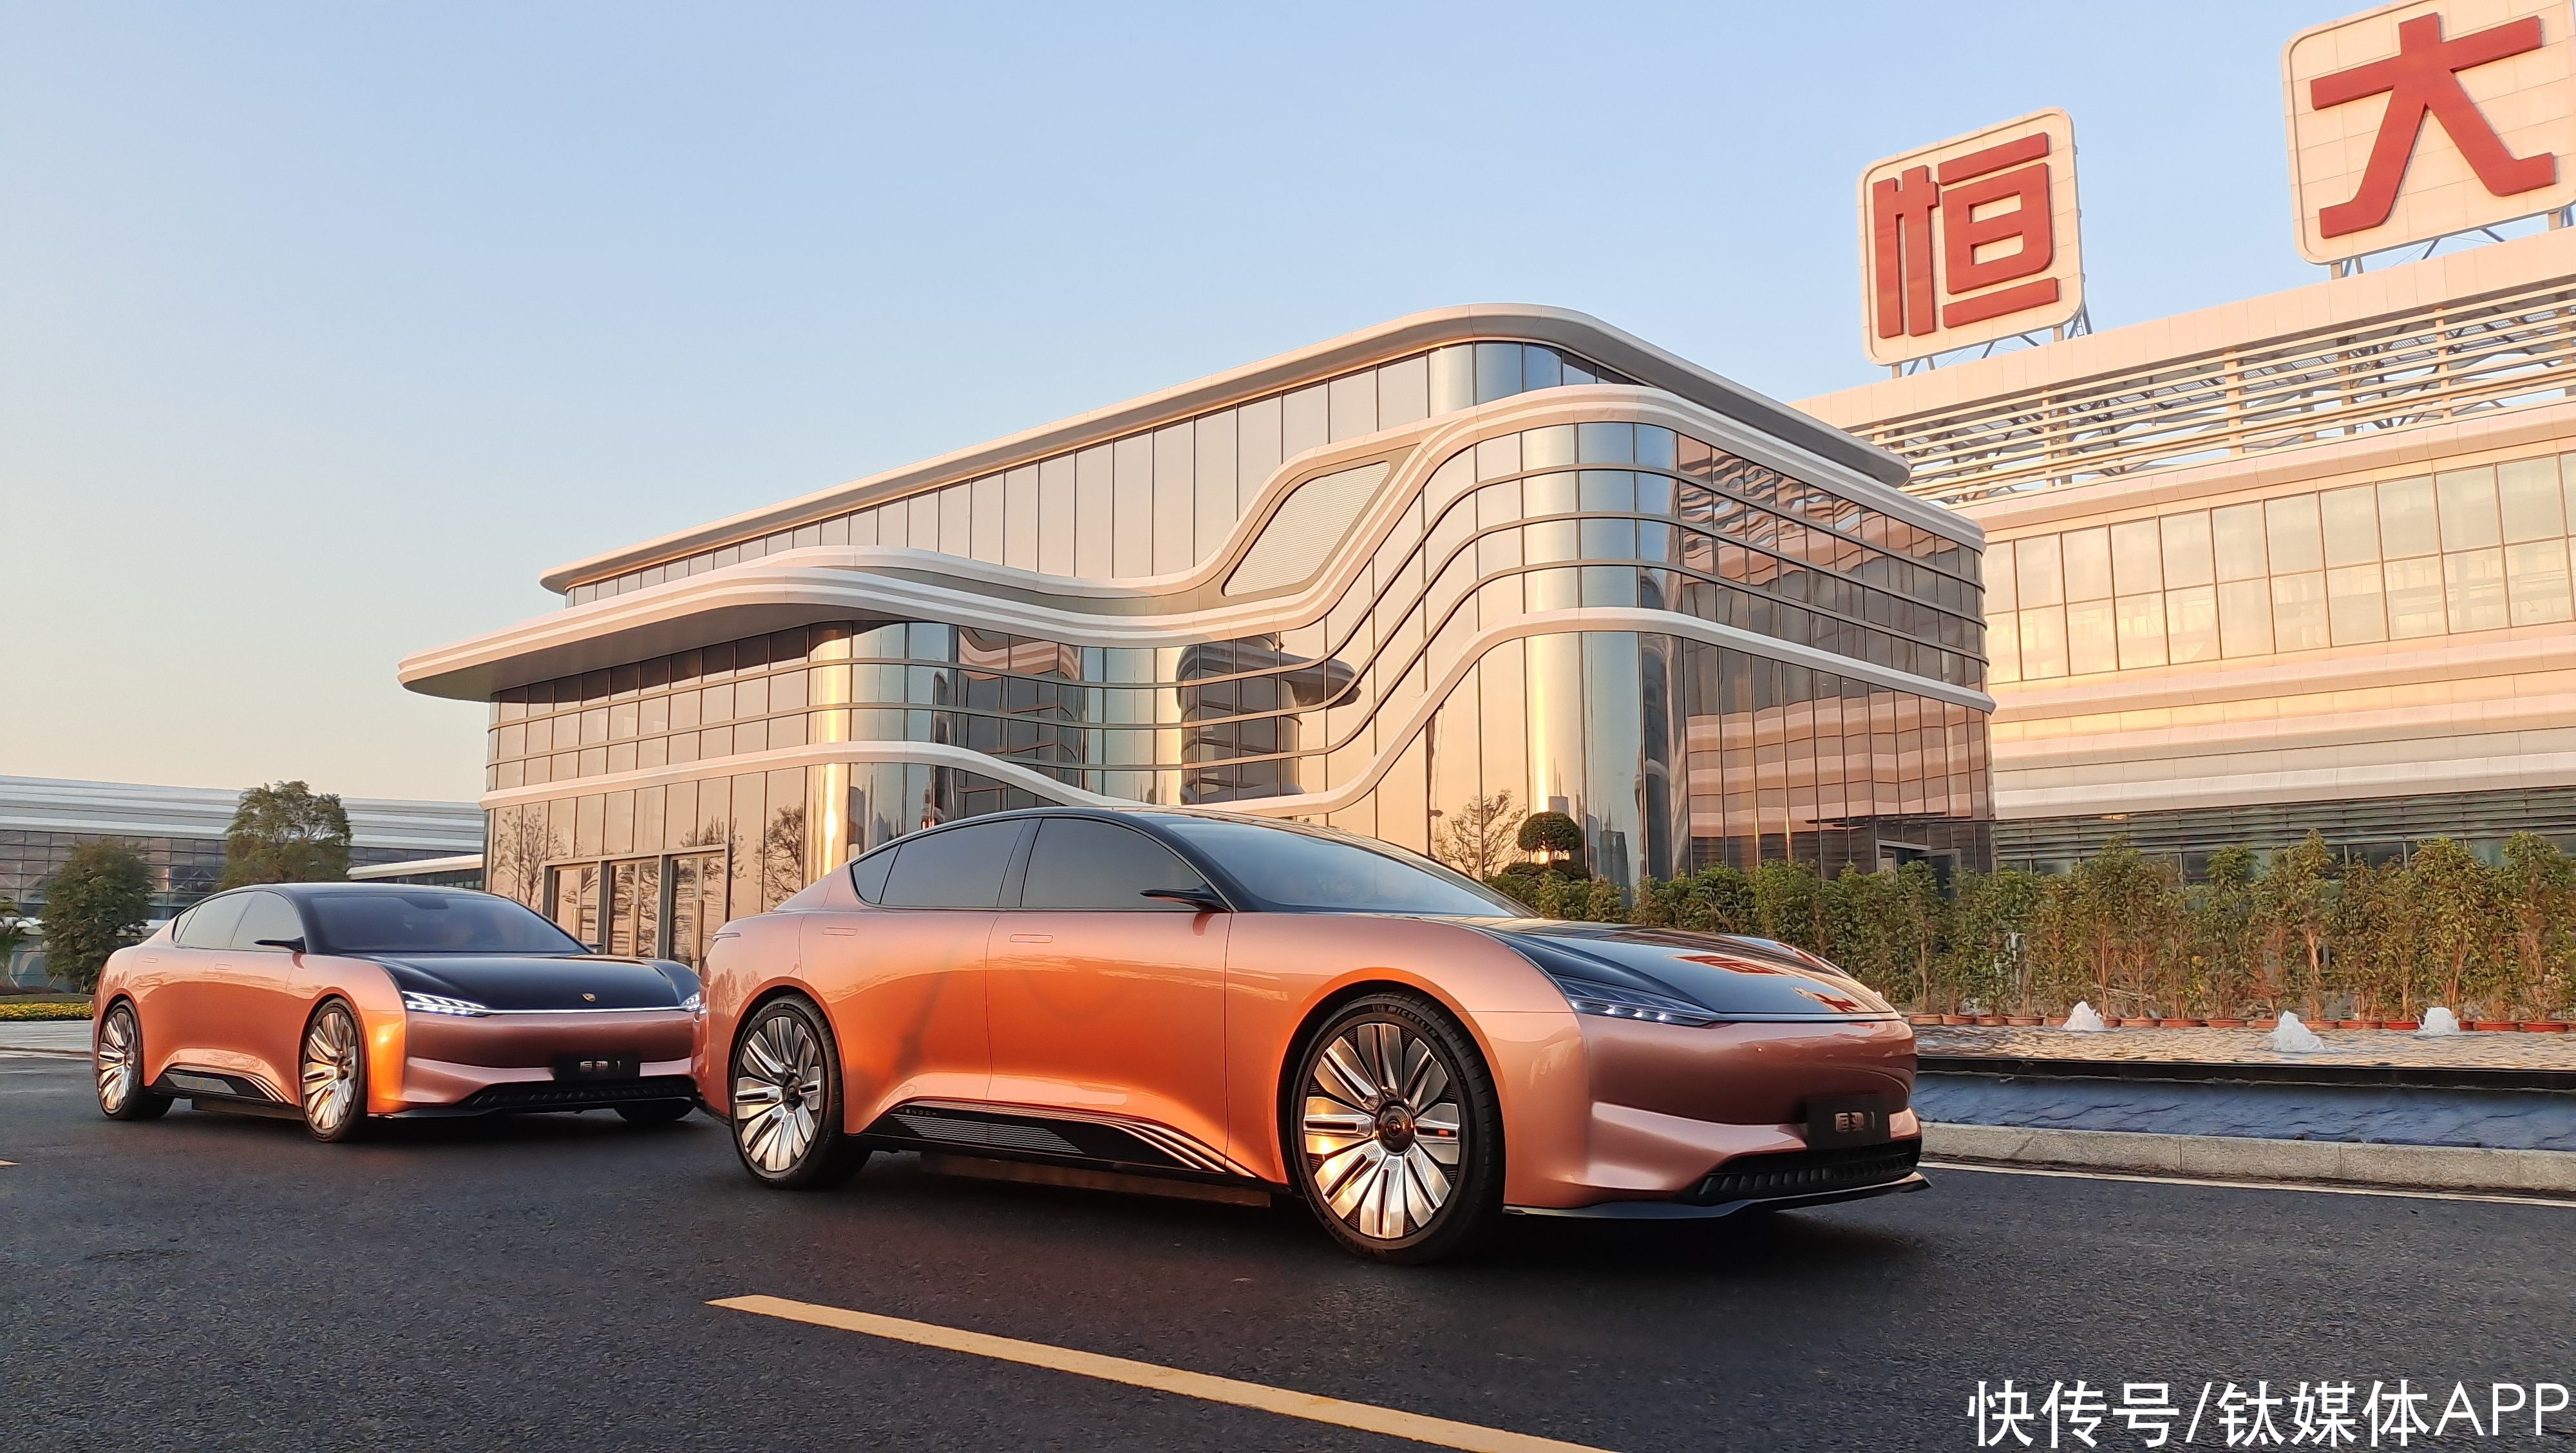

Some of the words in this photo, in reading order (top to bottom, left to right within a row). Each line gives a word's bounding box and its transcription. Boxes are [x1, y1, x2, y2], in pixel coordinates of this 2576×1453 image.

[1873, 132, 2060, 339] 恒
[2310, 12, 2556, 238] 大
[1387, 1005, 1439, 1040] MICHELIN
